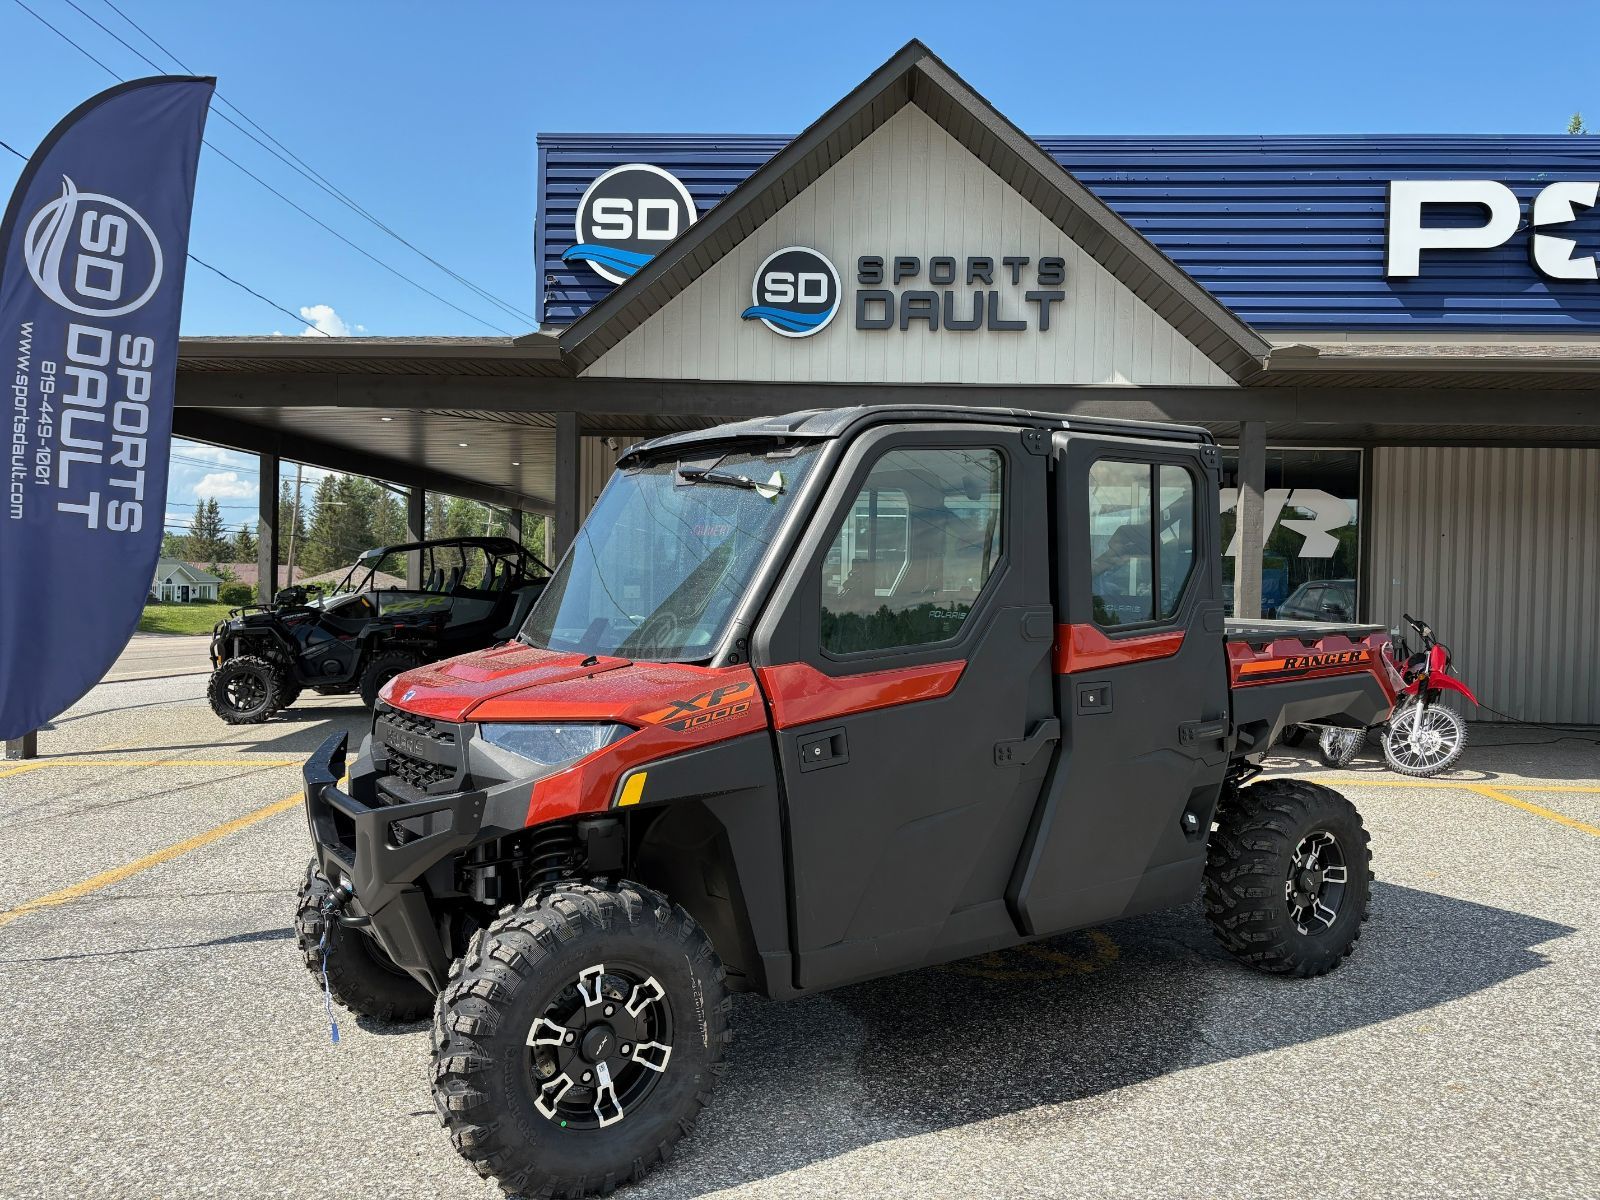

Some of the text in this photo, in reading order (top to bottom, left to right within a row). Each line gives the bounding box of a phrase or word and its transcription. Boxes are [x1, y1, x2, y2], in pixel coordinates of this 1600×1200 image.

[591, 198, 679, 240] SD
[75, 210, 128, 301] SD
[856, 255, 1066, 285] SPORTS
[764, 271, 828, 304] SD
[855, 289, 1066, 331] DAULT
[10, 321, 34, 520] www.sportsdault.com
[35, 360, 57, 486] 819-449-1001
[57, 323, 112, 529] DAULT
[106, 333, 155, 533] SPORTS
[929, 610, 967, 620] POLARIS
[1283, 650, 1362, 669] RANGER
[657, 681, 753, 721] XP
[684, 700, 752, 729] 1000
